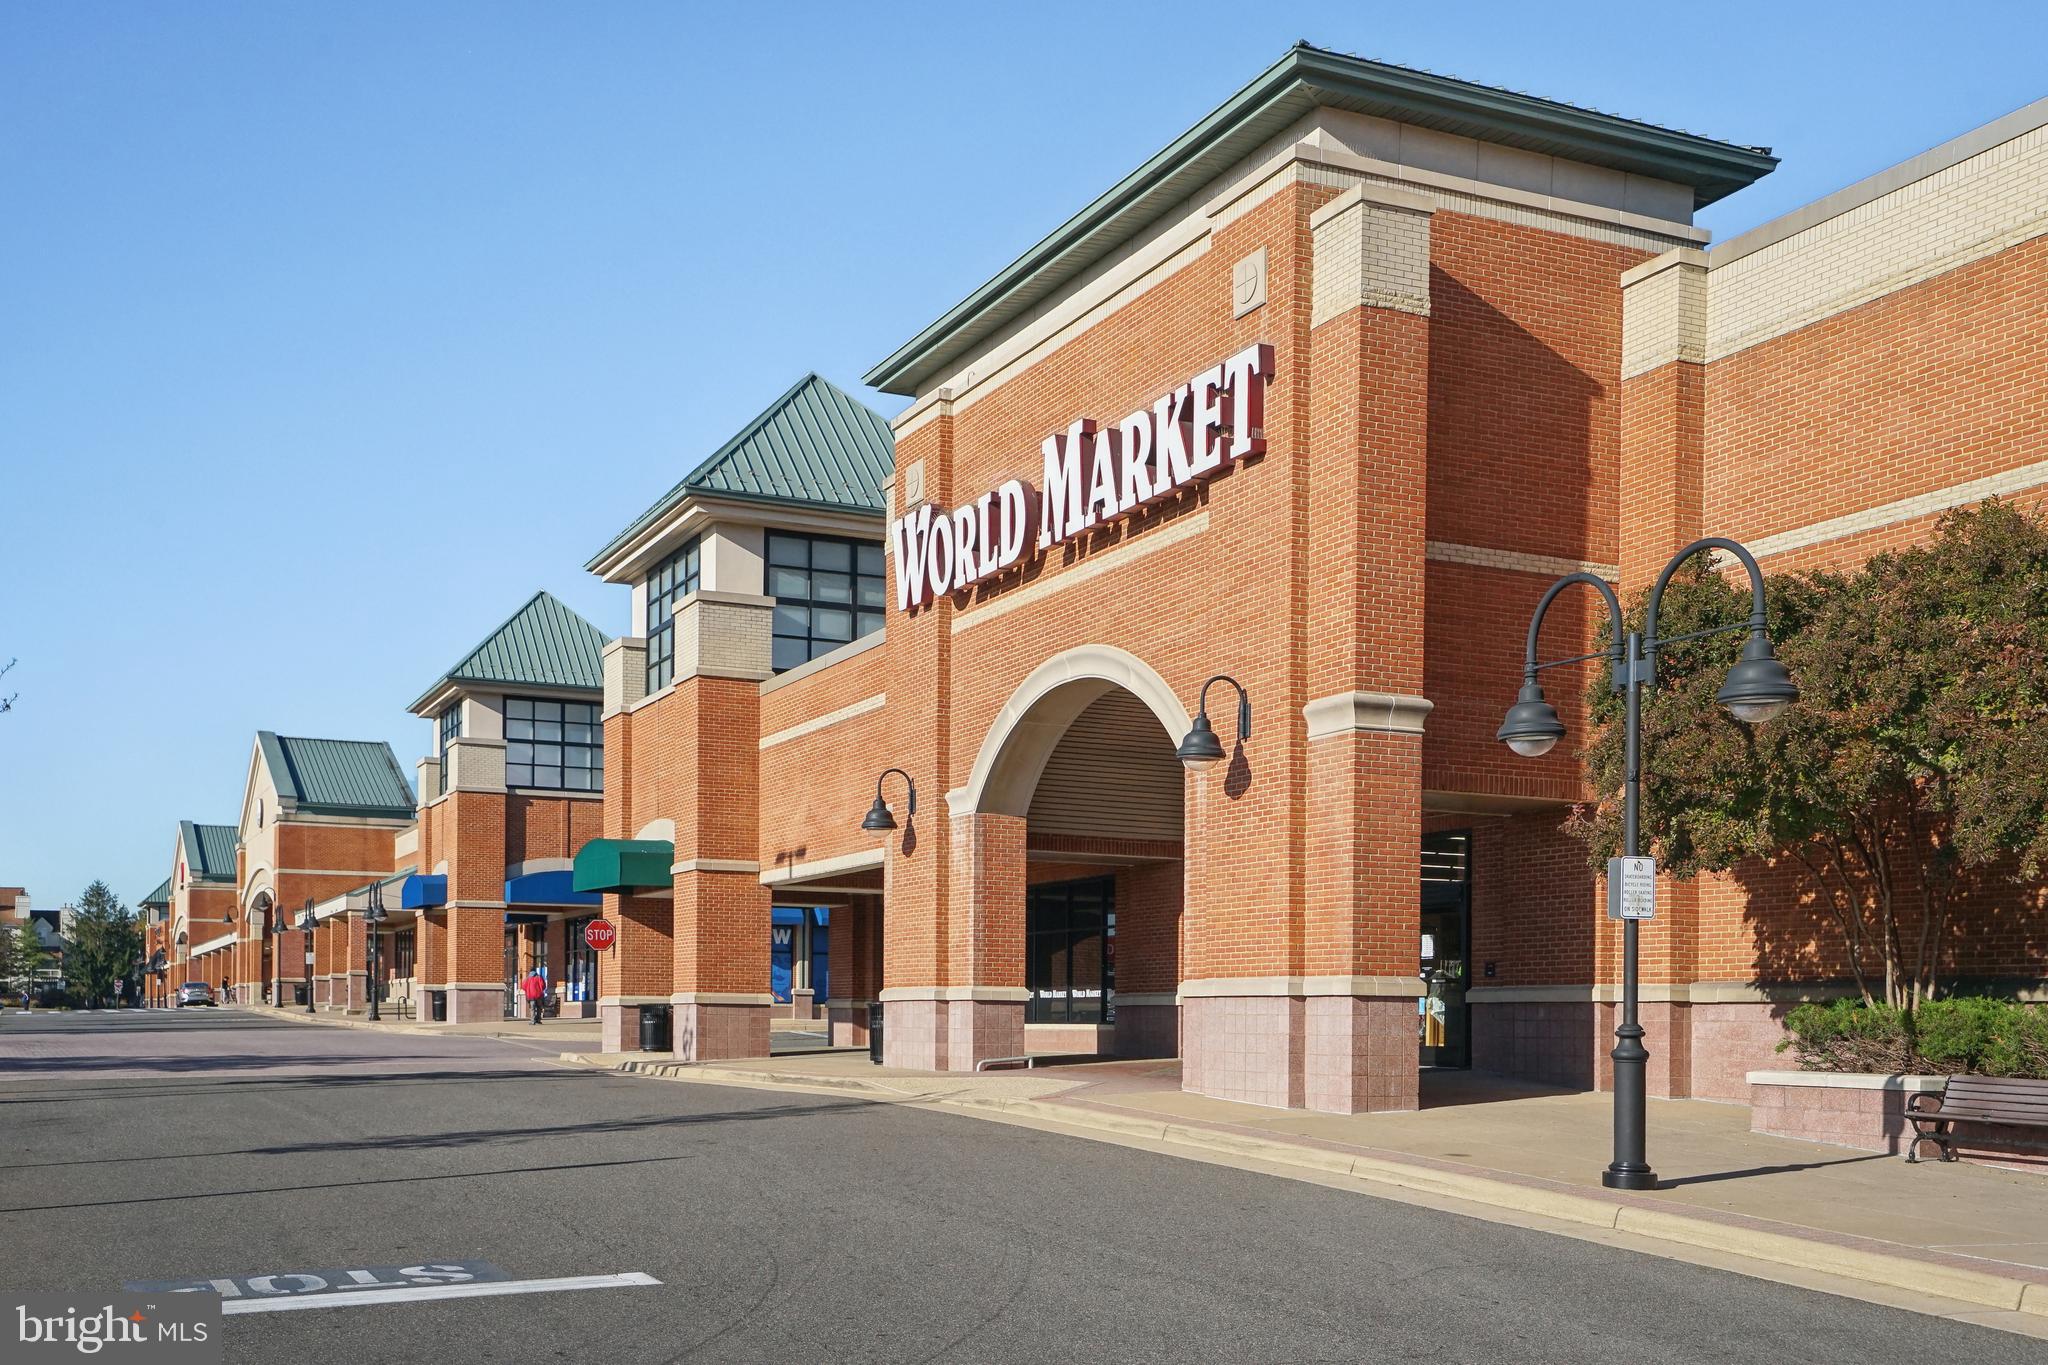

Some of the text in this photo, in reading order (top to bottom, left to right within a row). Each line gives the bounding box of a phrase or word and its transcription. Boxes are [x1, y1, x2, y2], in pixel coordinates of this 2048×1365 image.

[891, 343, 1275, 612] WORLD MARKET
[1633, 863, 1643, 871] NO
[587, 929, 613, 941] STOP
